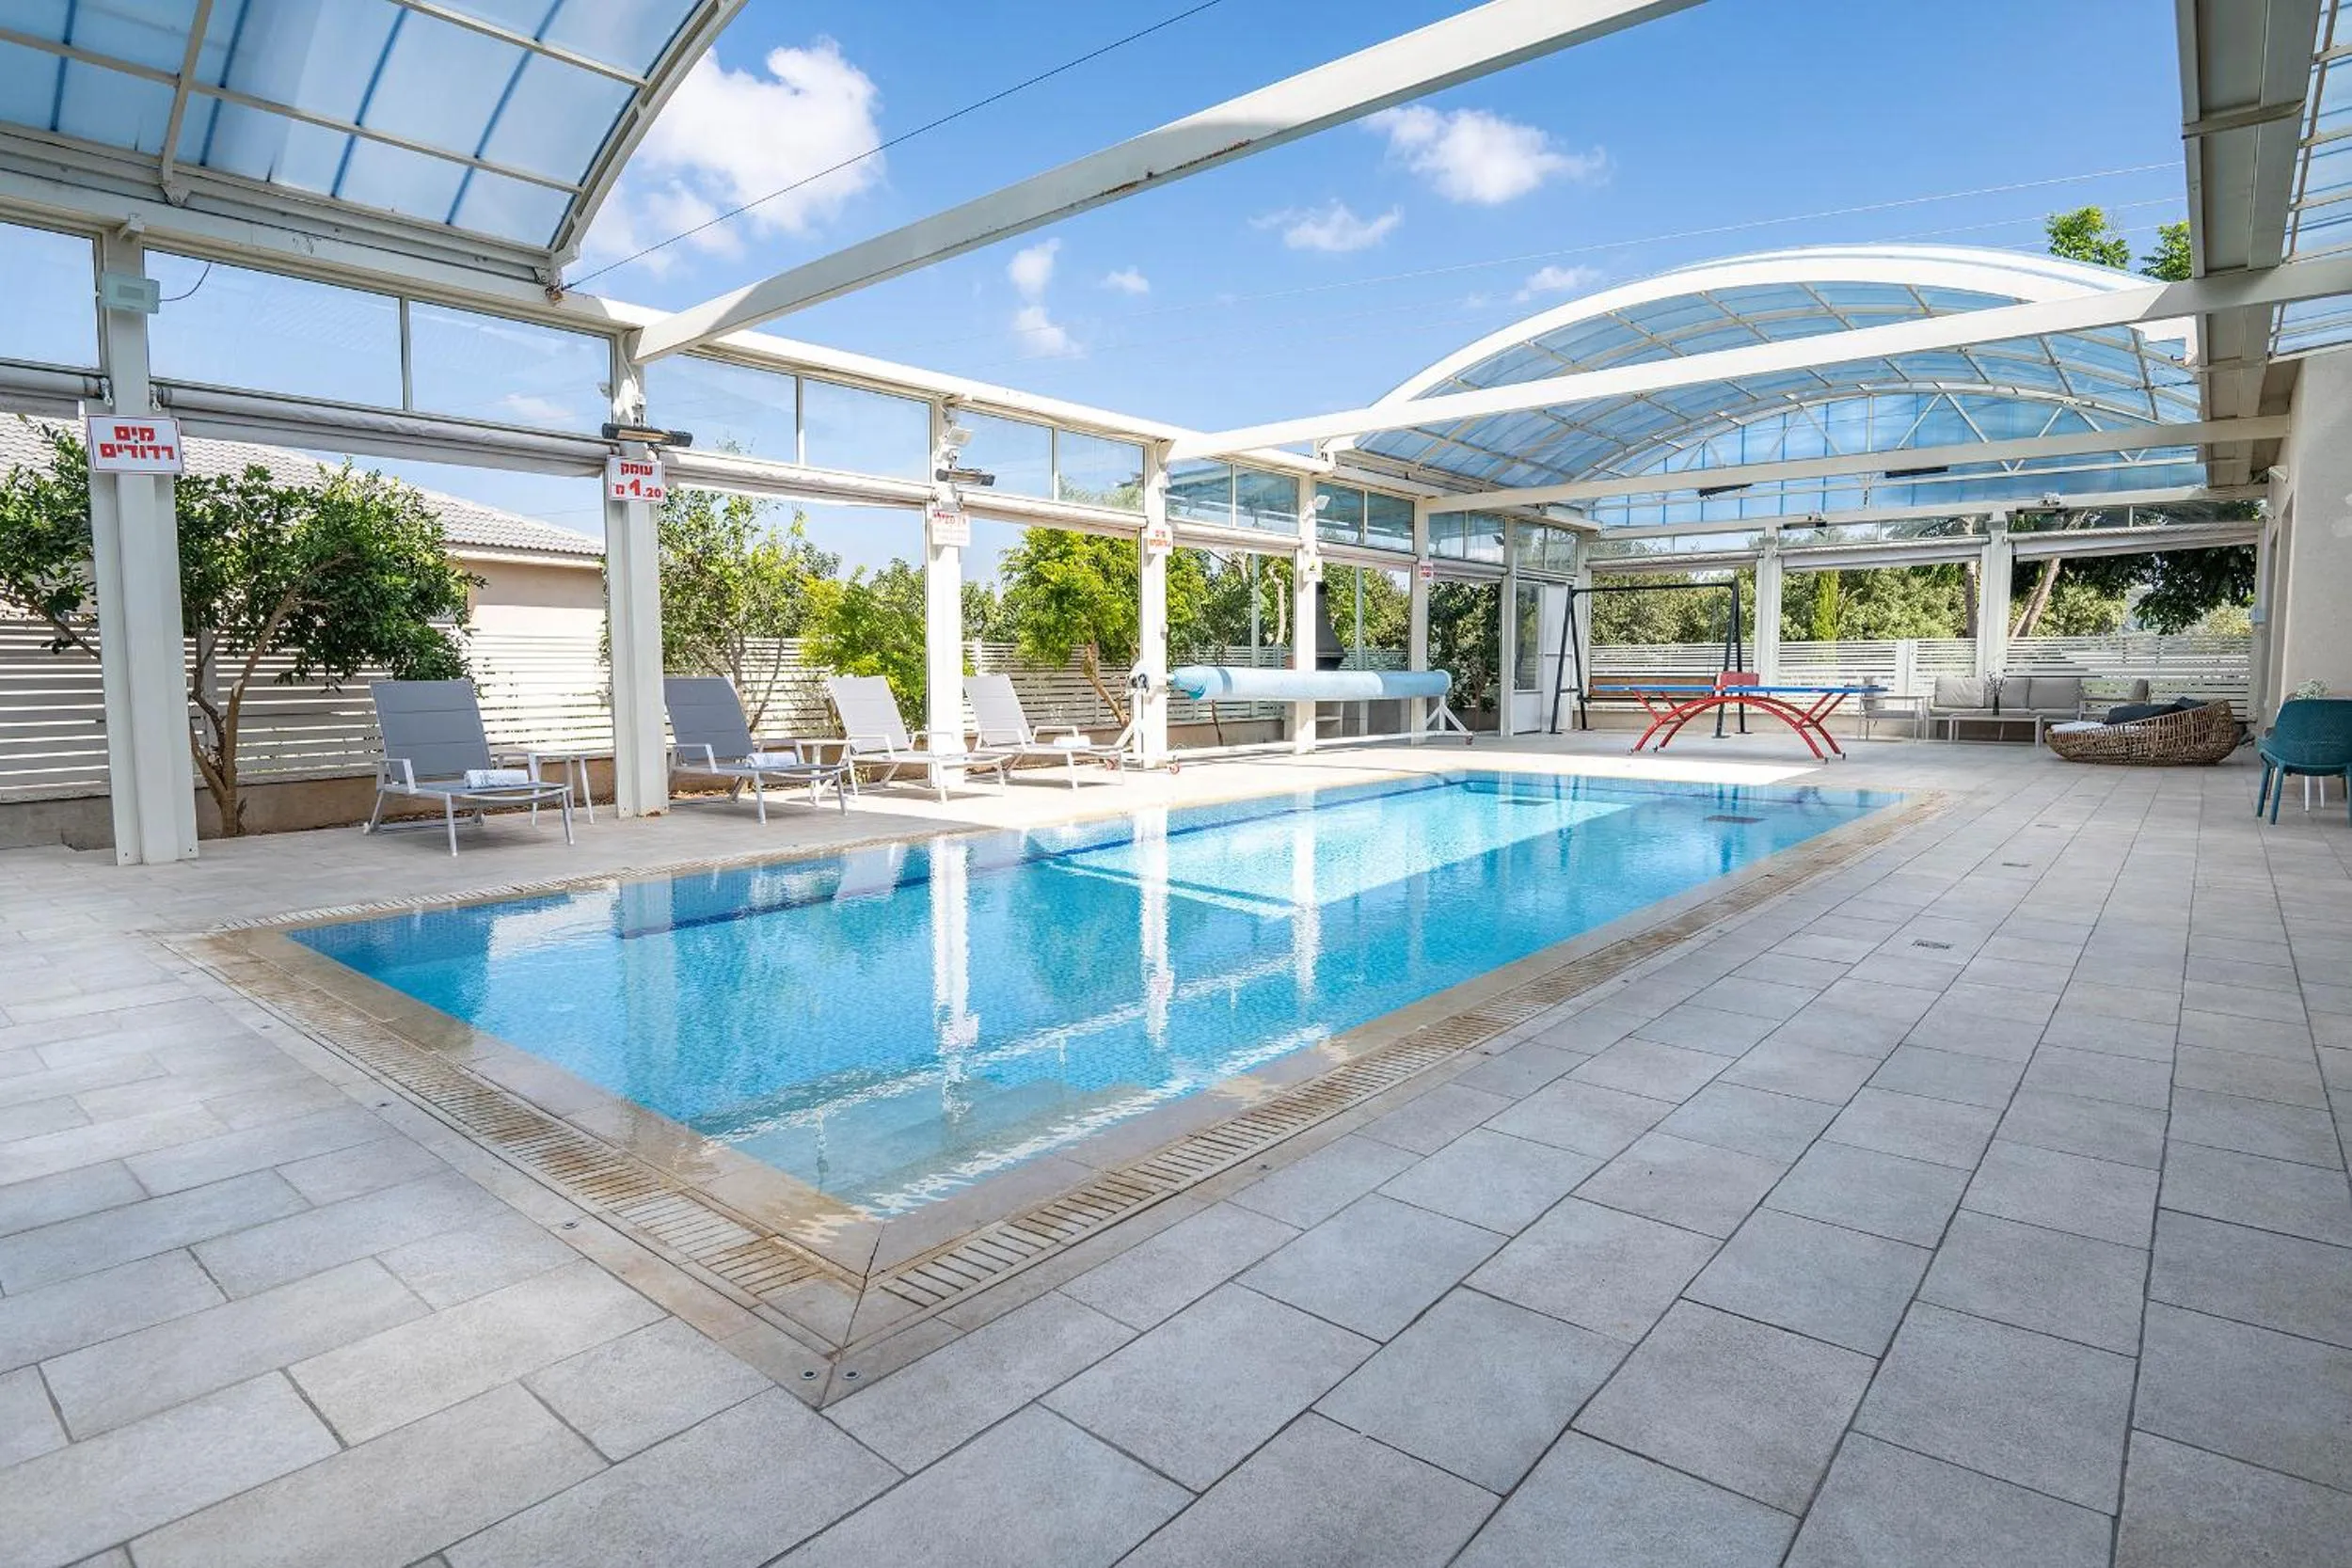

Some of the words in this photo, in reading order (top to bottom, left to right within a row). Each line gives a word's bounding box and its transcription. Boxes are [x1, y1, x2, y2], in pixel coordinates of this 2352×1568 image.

[114, 426, 155, 441] מים
[100, 443, 174, 460] רדודים
[620, 463, 653, 476] עומק
[629, 479, 661, 499] 1.20
